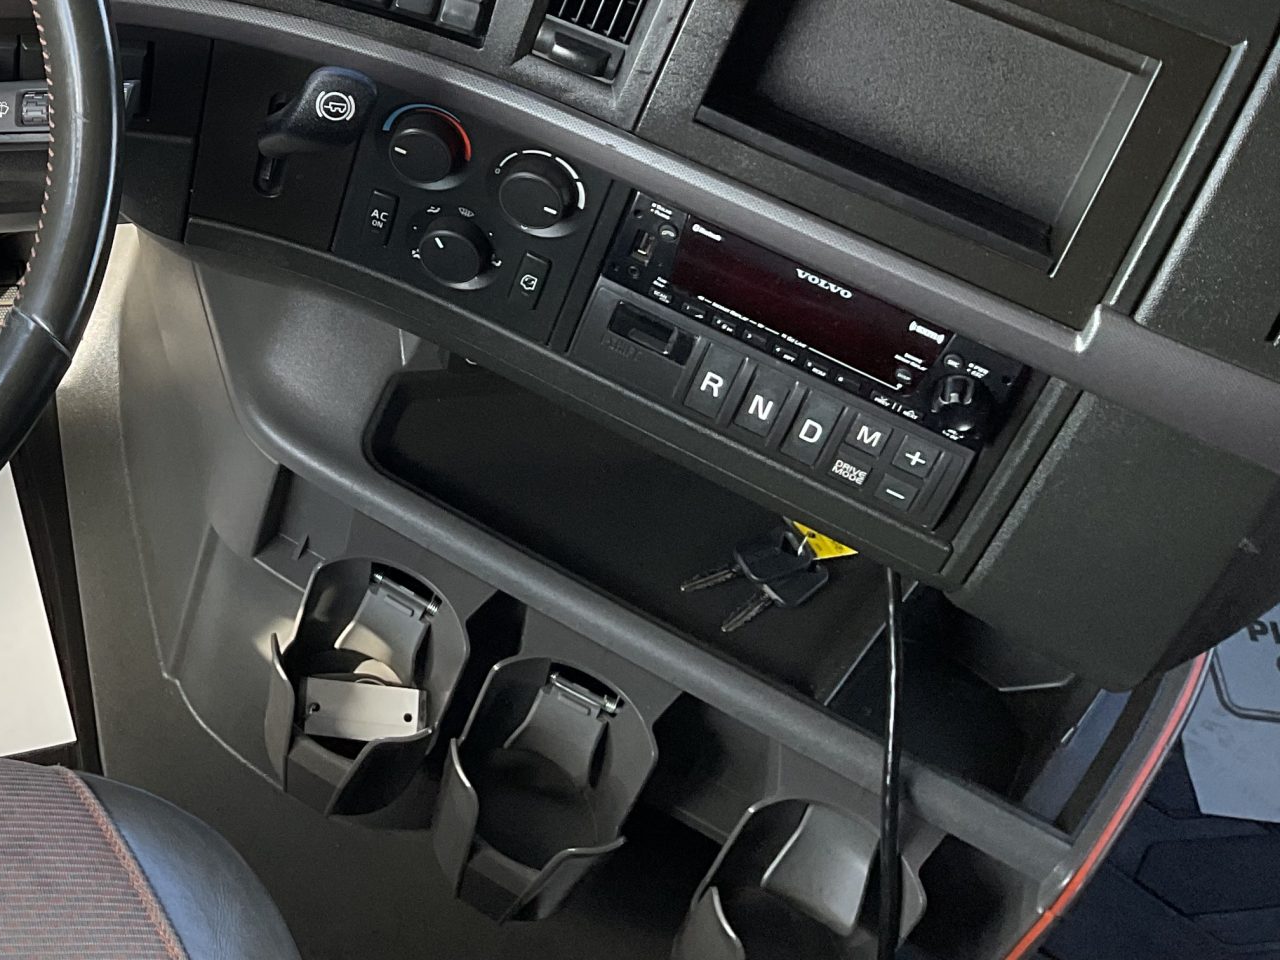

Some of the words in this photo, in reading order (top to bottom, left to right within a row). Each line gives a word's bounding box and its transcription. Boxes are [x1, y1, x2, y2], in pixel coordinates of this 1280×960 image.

[371, 208, 388, 223] AC
[371, 218, 384, 229] ON
[795, 268, 853, 300] VOLVO
[699, 370, 724, 398] R
[748, 394, 774, 421] N
[798, 418, 823, 444] D
[856, 425, 882, 448] M
[831, 464, 865, 486] MODE
[834, 458, 868, 480] DRIVE
